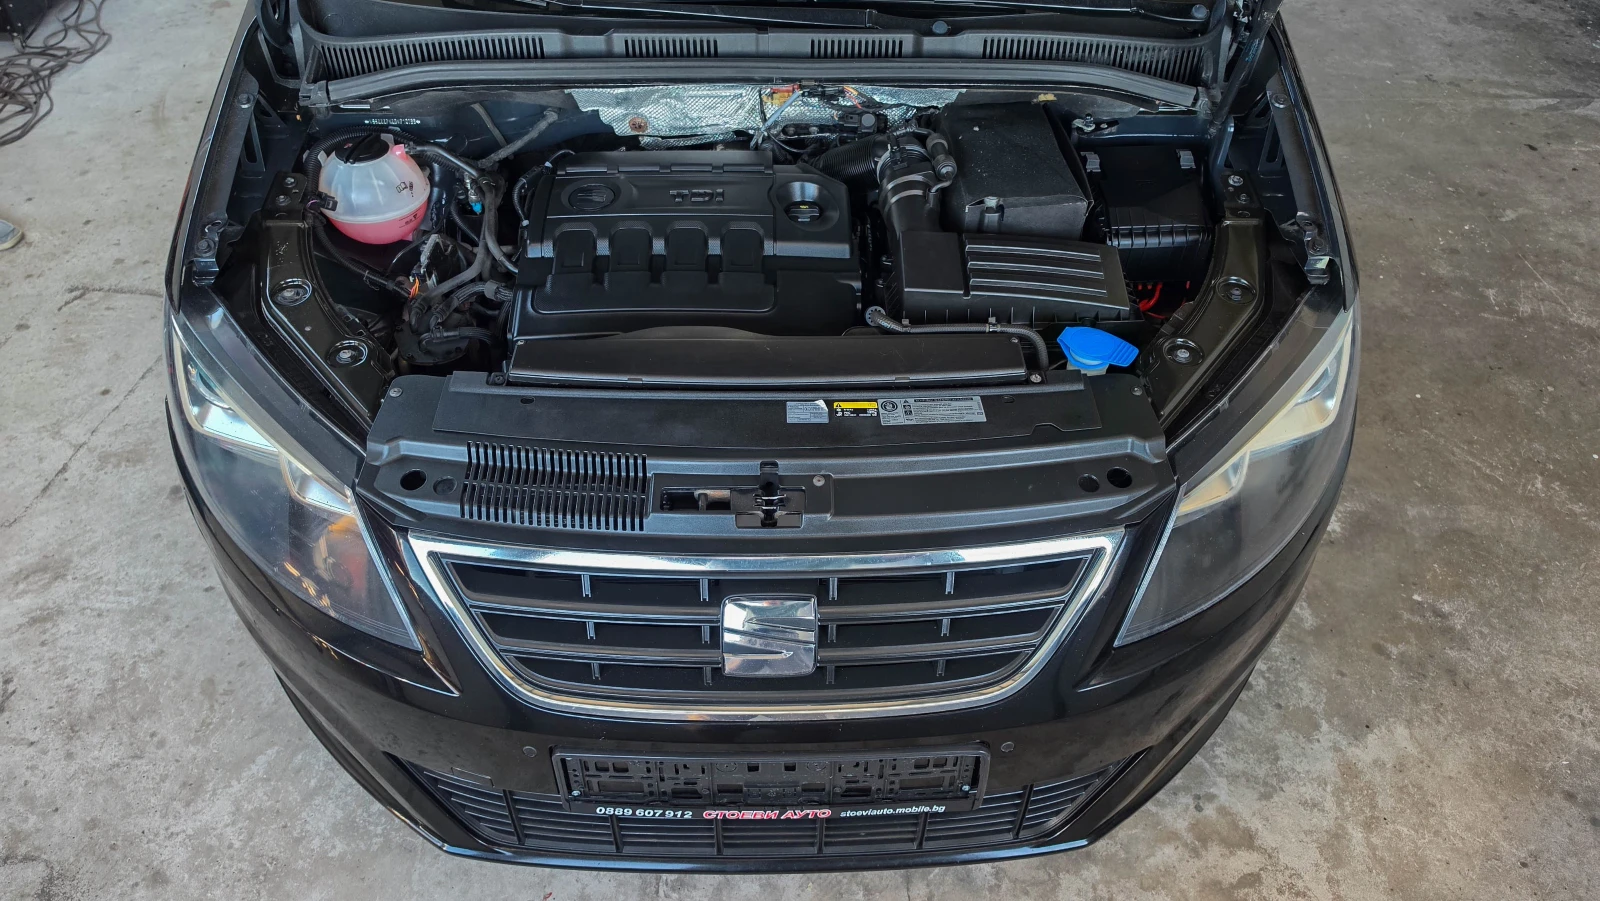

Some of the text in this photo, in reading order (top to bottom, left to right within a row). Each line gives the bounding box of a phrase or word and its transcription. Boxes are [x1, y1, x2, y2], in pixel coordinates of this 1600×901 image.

[669, 189, 724, 202] TDI
[596, 807, 692, 818] 0889 607 912
[703, 809, 831, 819] СТОЕВИ АУТО
[840, 804, 946, 817] stoeviauto.mobile.bg
